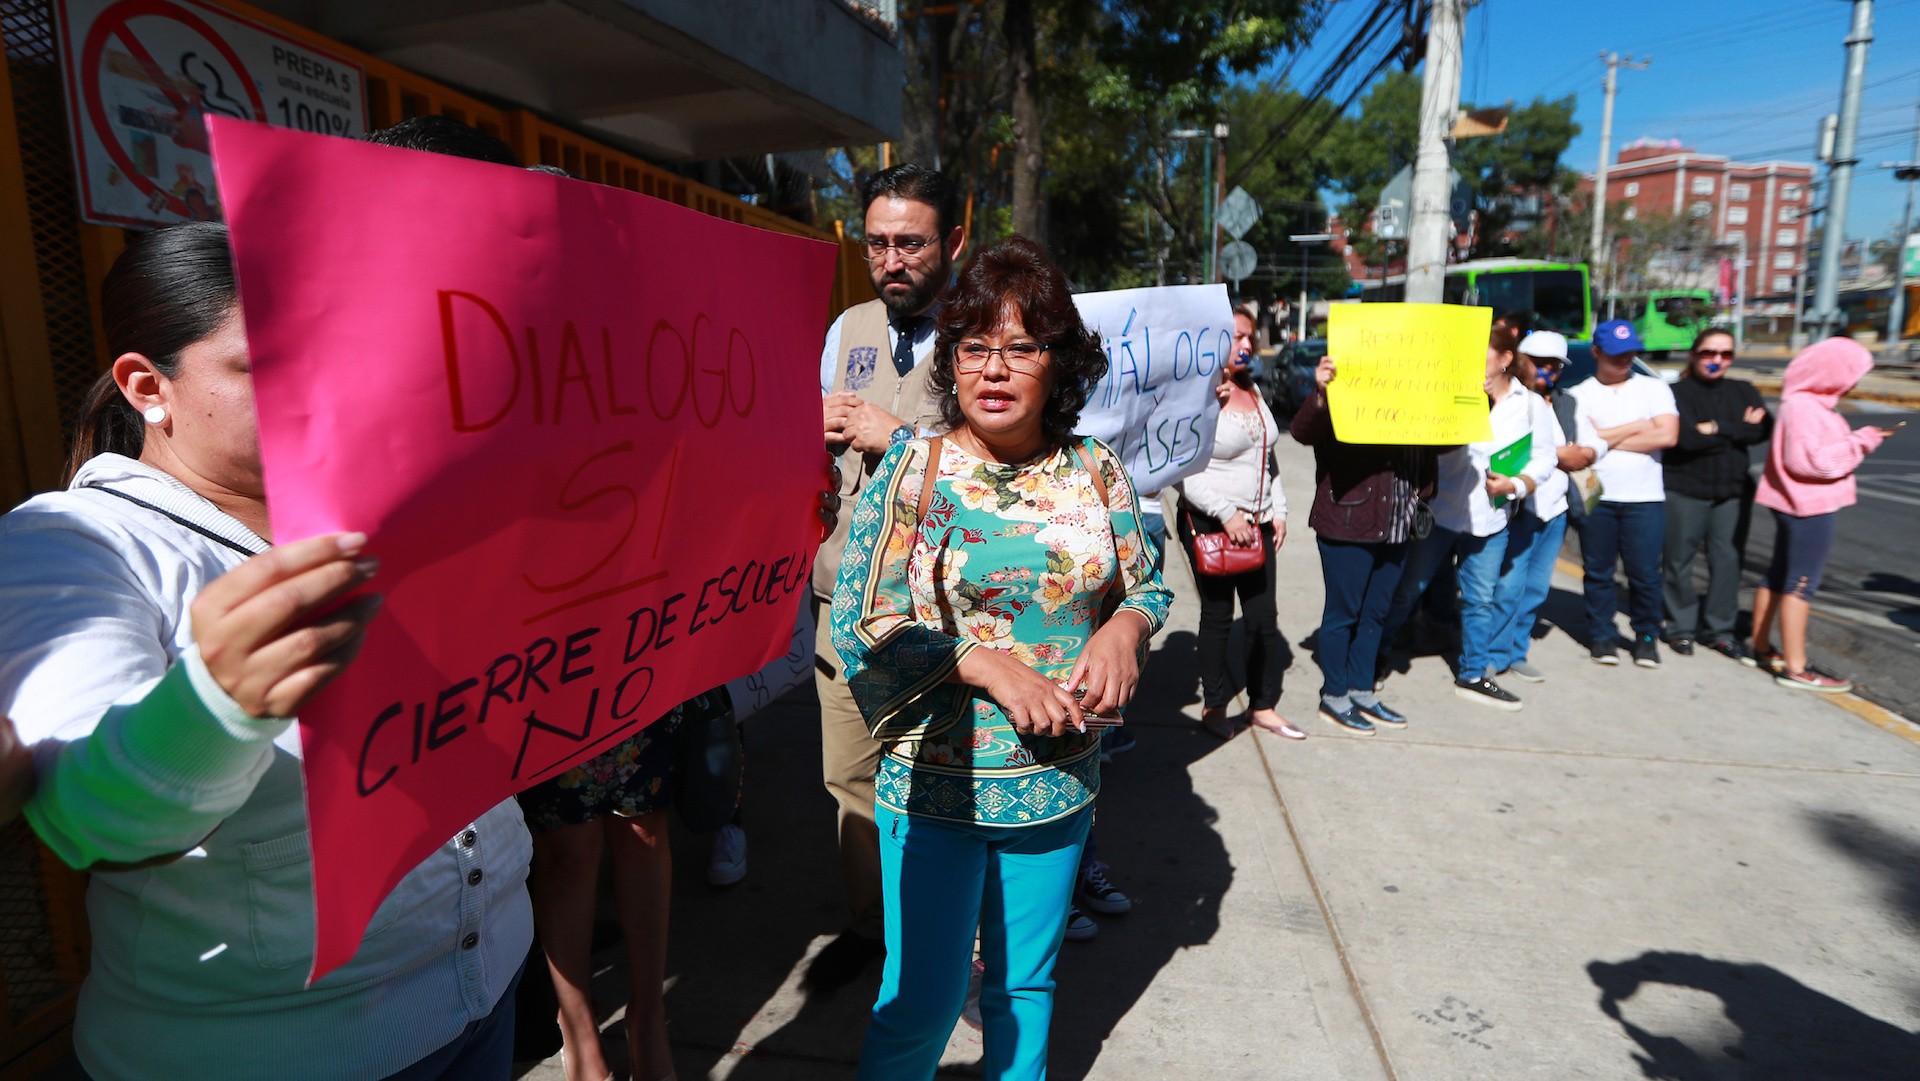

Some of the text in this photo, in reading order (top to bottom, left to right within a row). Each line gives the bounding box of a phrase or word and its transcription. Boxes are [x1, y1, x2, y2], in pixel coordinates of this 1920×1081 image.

[272, 45, 351, 92] PREPA 5
[277, 75, 351, 110] una escuela
[437, 289, 756, 433] DIALOGO
[1360, 328, 1453, 352] RESPETEN
[1107, 413, 1202, 474] ASES
[357, 548, 808, 799] CIERRE DE ESCUELA
[510, 666, 655, 782] NO
